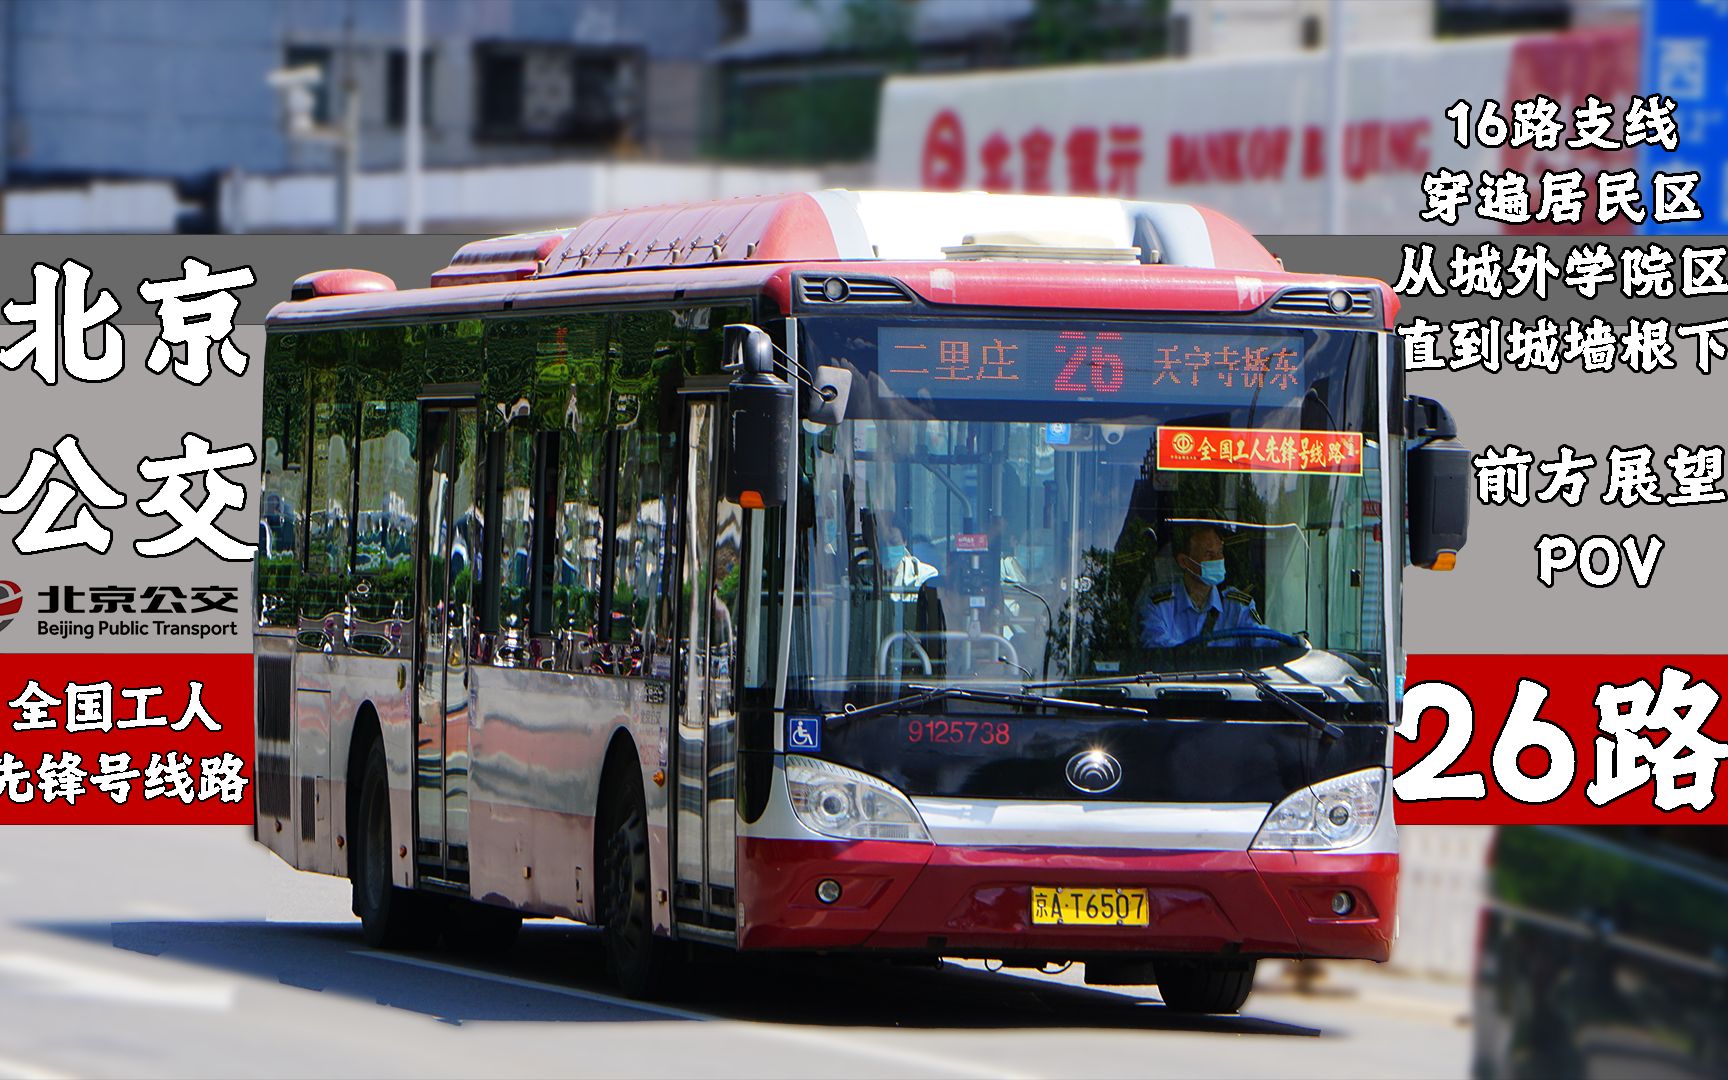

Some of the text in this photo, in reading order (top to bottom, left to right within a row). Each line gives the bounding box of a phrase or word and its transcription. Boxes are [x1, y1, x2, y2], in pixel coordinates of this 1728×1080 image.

[889, 330, 1299, 393] 二里庄 26 天宁寺桥东
[1197, 434, 1346, 470] 全国工人先锋号线路
[907, 719, 1011, 745] 9125738
